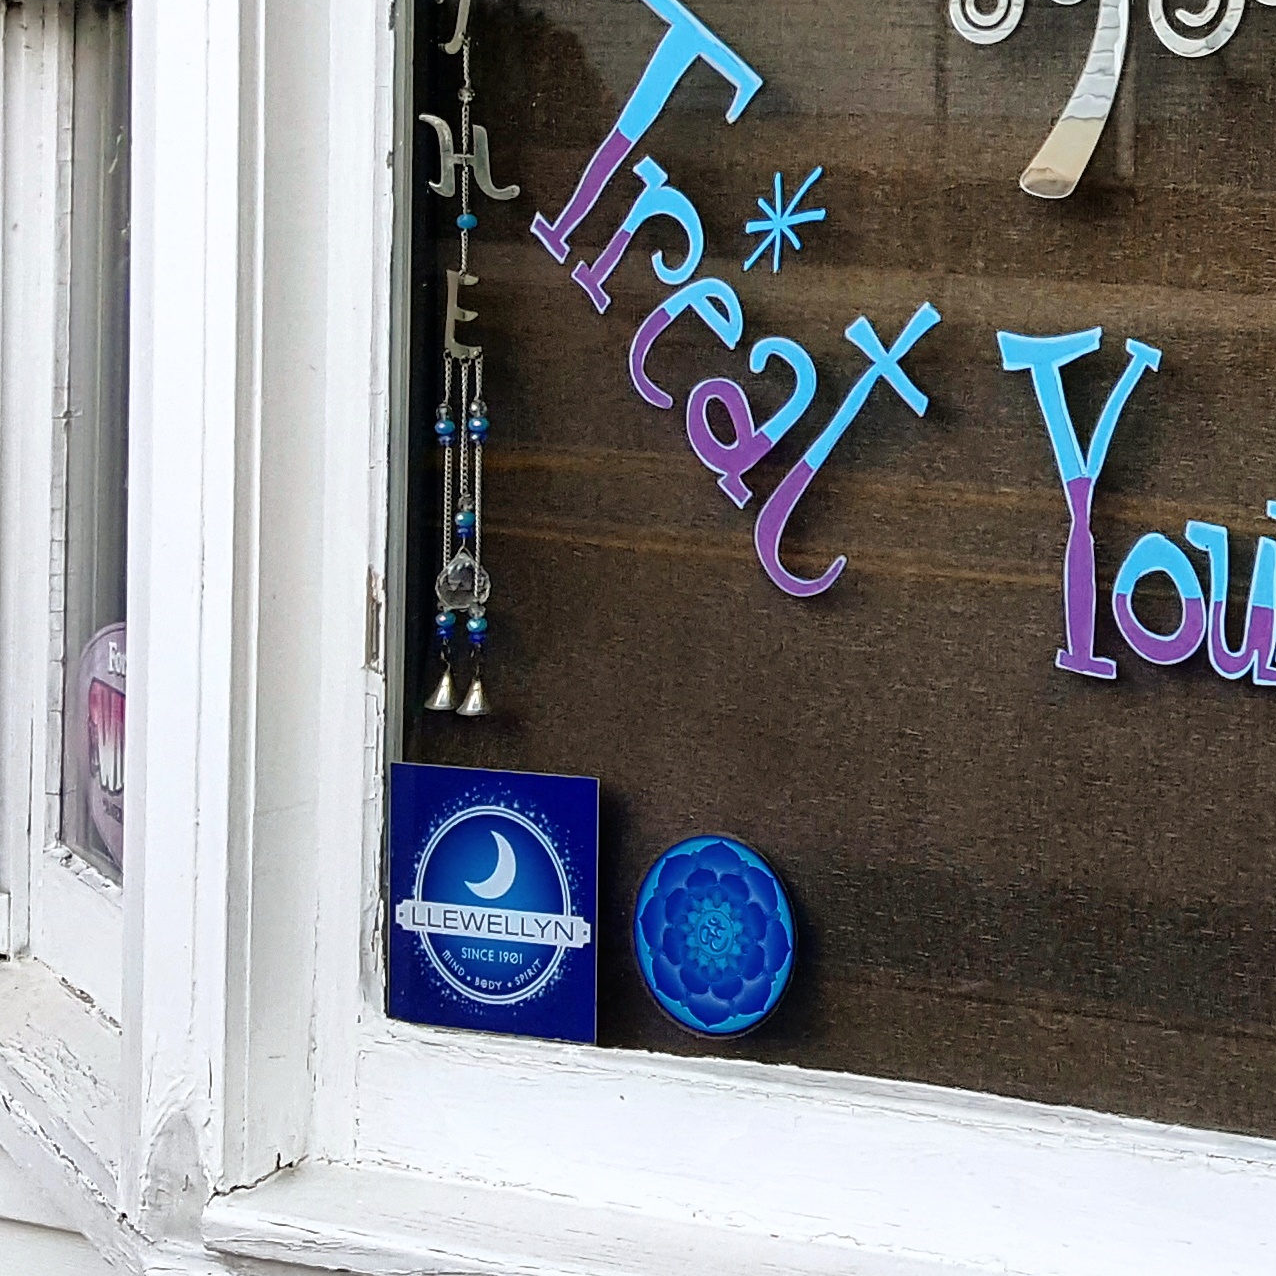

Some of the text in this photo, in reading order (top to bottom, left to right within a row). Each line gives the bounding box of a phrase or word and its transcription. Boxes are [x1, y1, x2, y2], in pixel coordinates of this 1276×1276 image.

[411, 905, 575, 941] LLEWELLYN
[441, 949, 543, 991] MIND BODY SPIRIT
[461, 946, 524, 965] SINCE 1901
